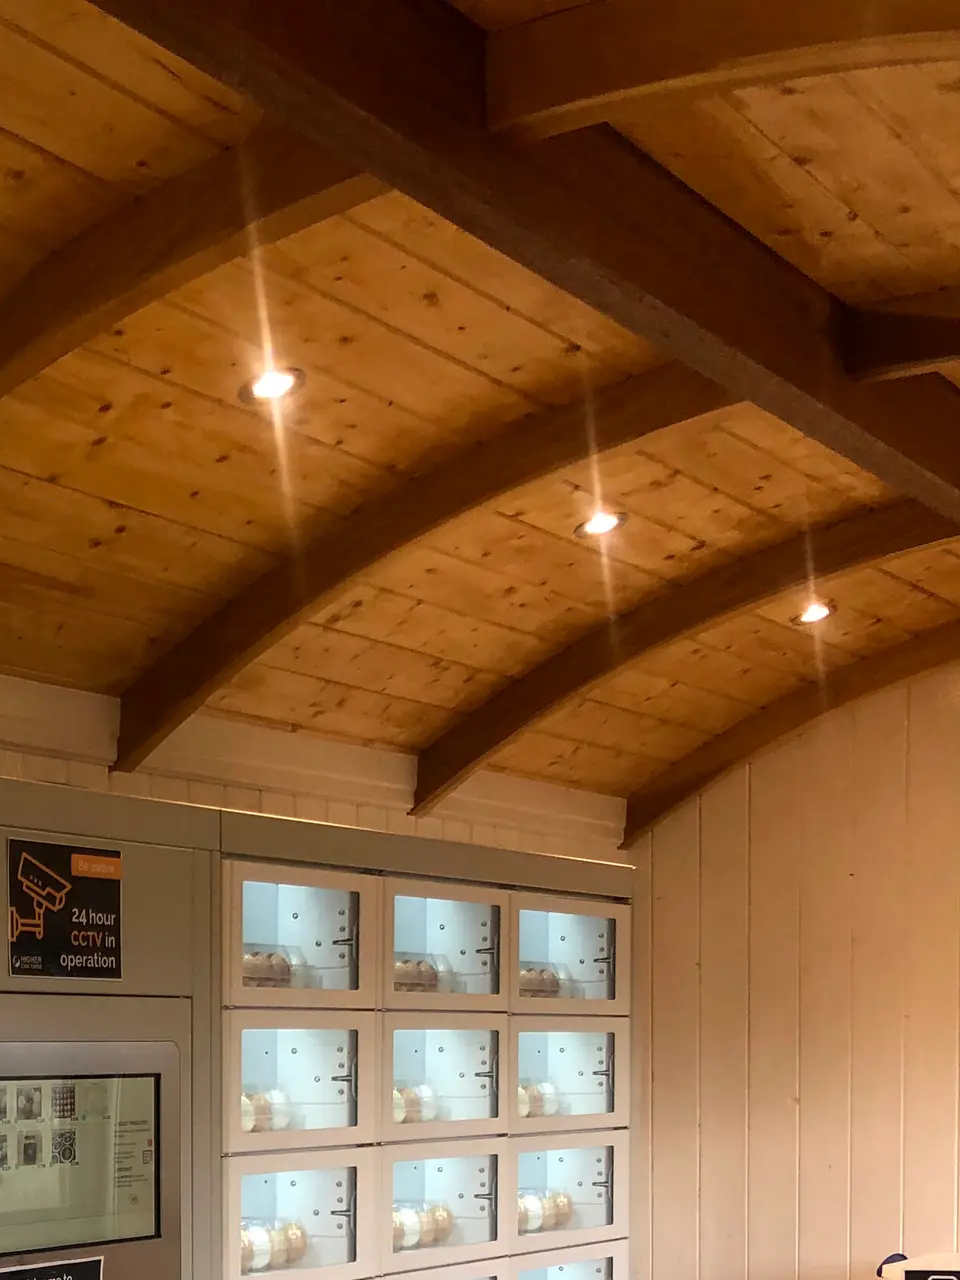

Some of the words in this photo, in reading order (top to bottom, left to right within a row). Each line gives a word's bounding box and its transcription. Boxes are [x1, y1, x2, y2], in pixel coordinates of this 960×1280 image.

[71, 908, 87, 926] 24
[89, 909, 116, 925] hour
[71, 930, 103, 947] CCTV
[105, 932, 116, 948] in
[60, 952, 116, 970] operation
